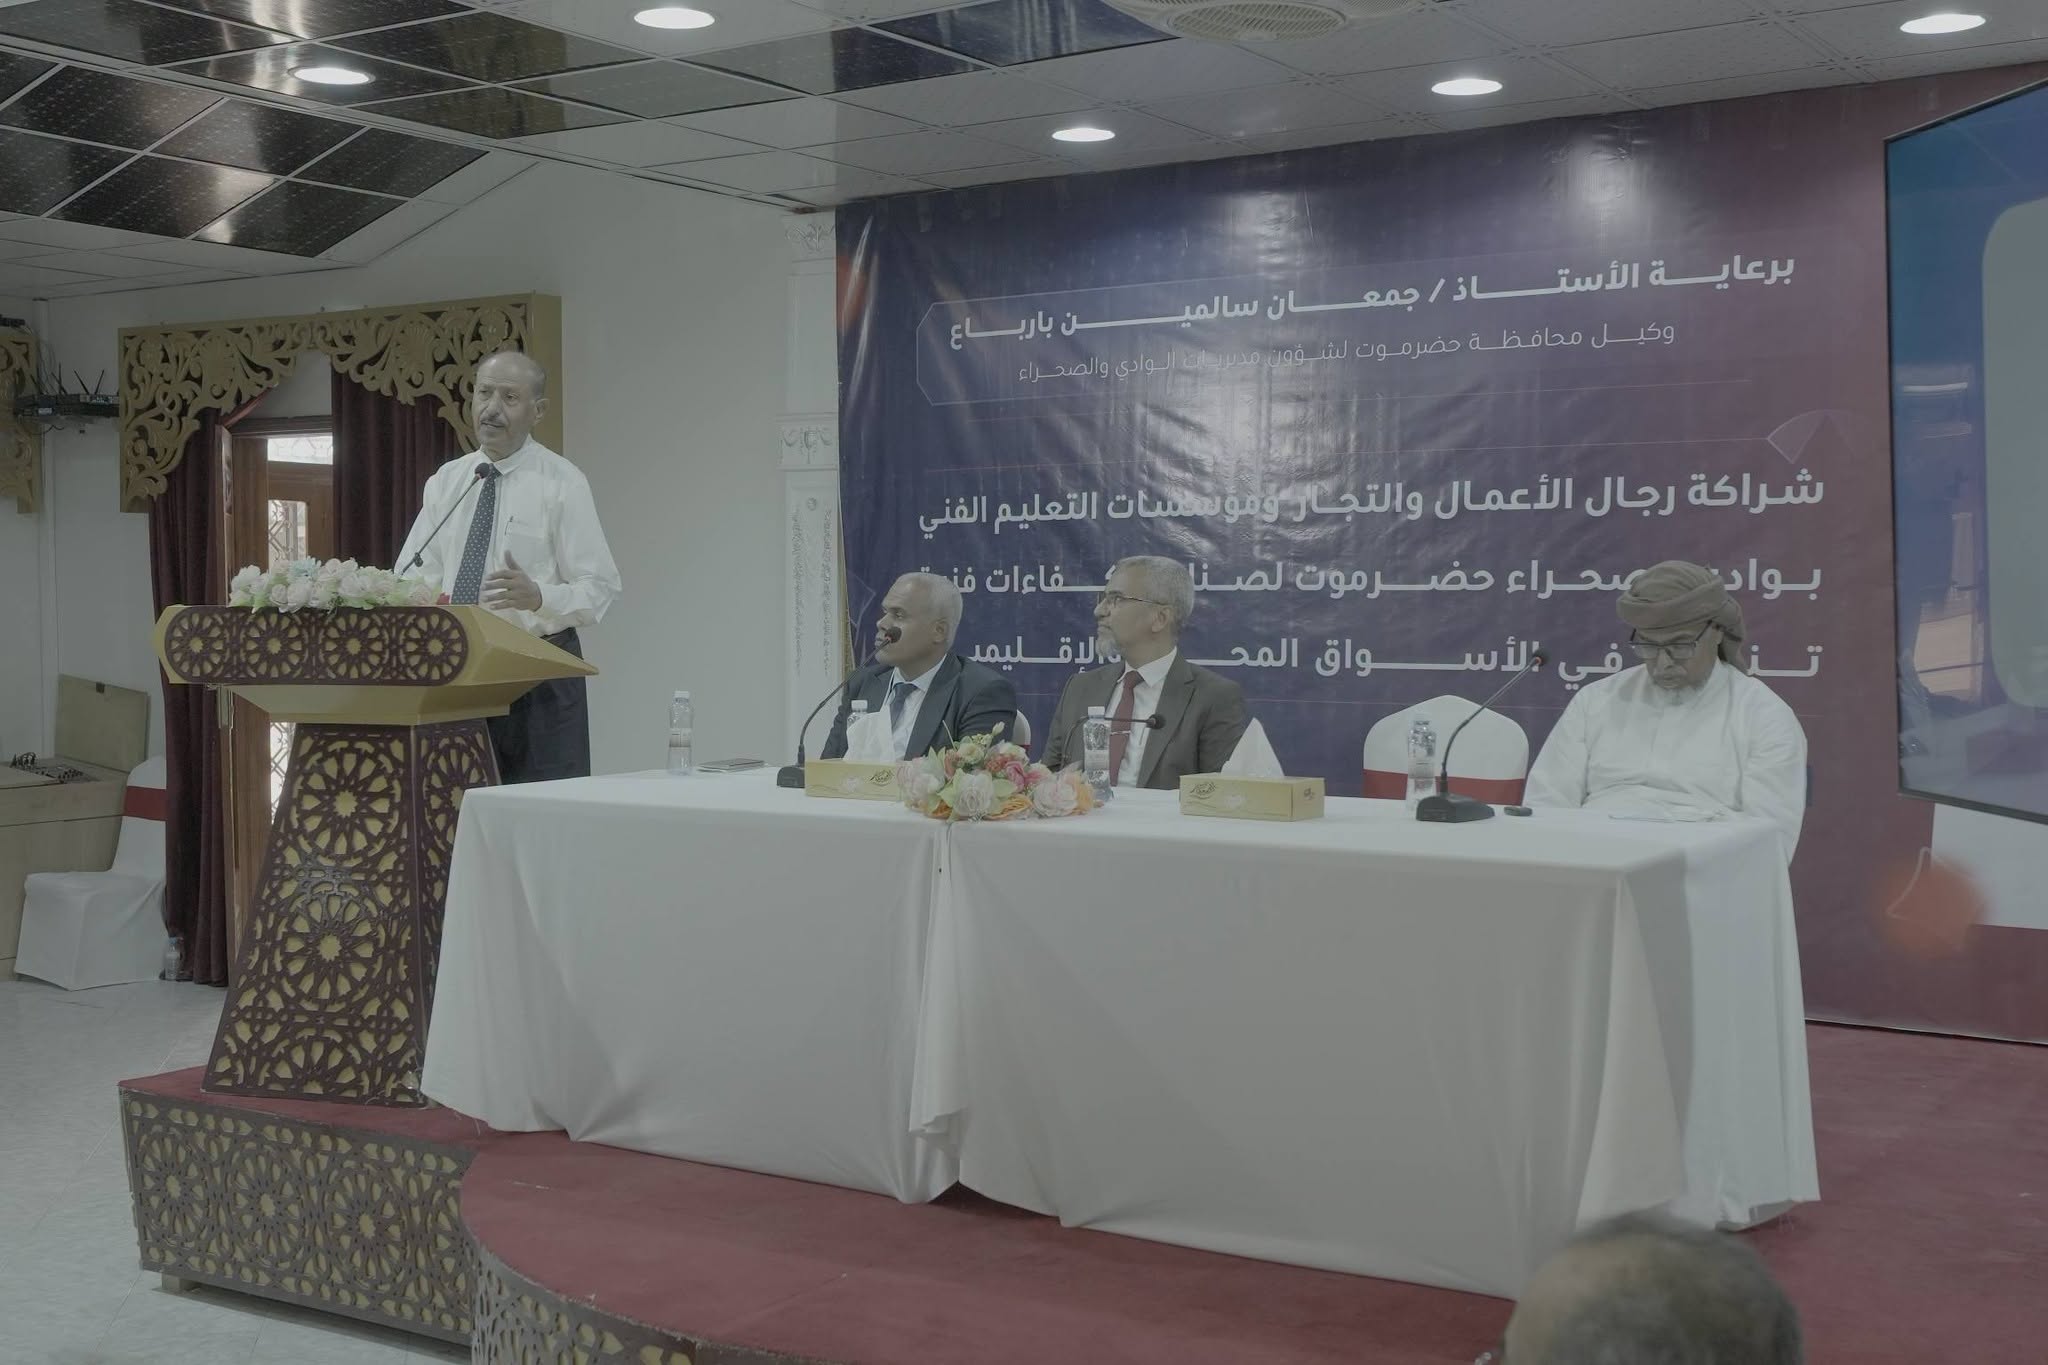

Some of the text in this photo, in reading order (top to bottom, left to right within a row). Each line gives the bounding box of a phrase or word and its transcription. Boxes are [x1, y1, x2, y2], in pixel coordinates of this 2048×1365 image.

[1648, 254, 1795, 290] برعاية
[1061, 295, 1259, 336] سالمين
[1266, 288, 1420, 320] جمعان
[950, 311, 1054, 350] بارباع
[1468, 327, 1583, 352] محافظة
[1591, 322, 1675, 349] وكيل
[1115, 351, 1176, 379] الوادي
[1267, 340, 1348, 368] لشؤون
[1355, 335, 1461, 362] حضرموت
[1018, 356, 1109, 383] والصحراء
[919, 468, 1824, 539] شراكة رجال الأعمال والتجار ومؤسسات التعليم الفني
[1193, 562, 1283, 592] لصنا
[1294, 561, 1496, 600] حضرموت
[1506, 559, 1648, 600] صحراء
[1712, 558, 1822, 600] بواد
[1558, 643, 1624, 691] في
